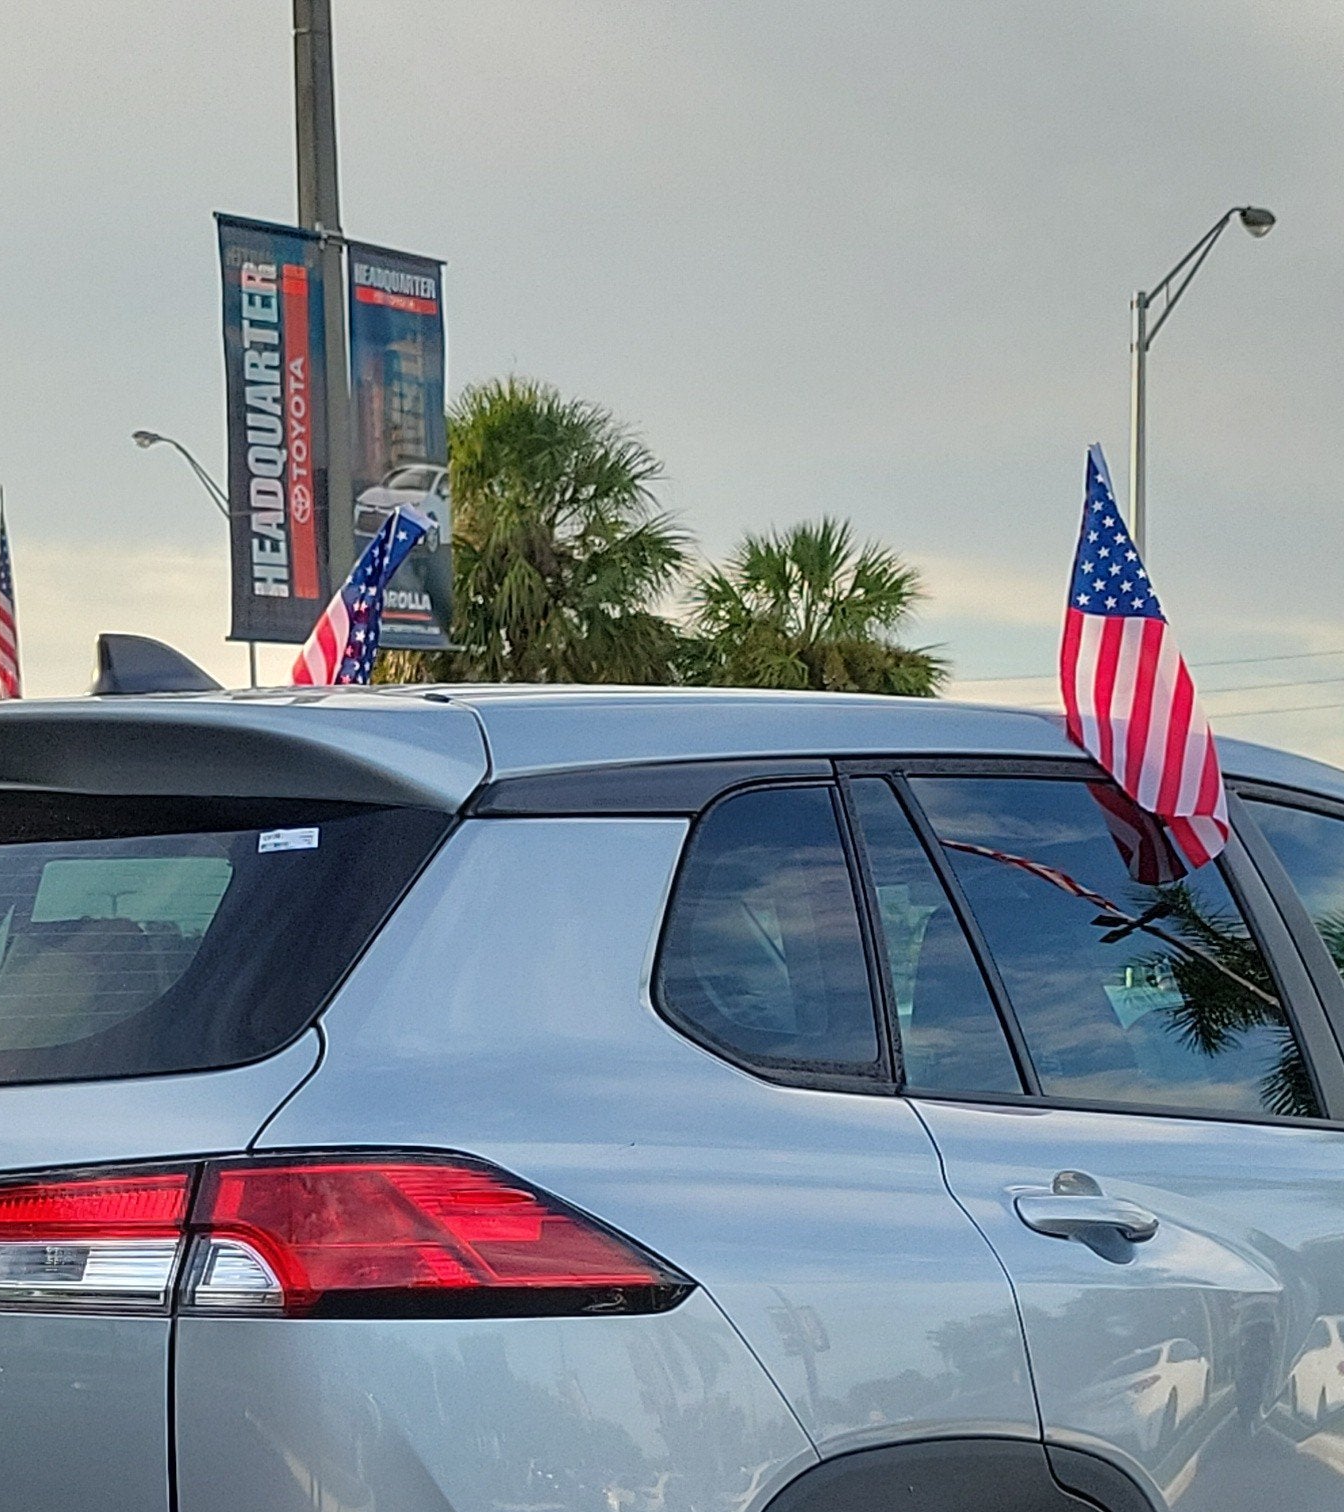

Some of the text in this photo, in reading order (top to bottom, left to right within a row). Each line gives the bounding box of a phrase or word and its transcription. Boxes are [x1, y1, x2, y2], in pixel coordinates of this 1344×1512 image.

[241, 262, 290, 599] HEADQUARTER
[288, 357, 308, 482] TOYOTA
[383, 588, 432, 611] ROLLA
